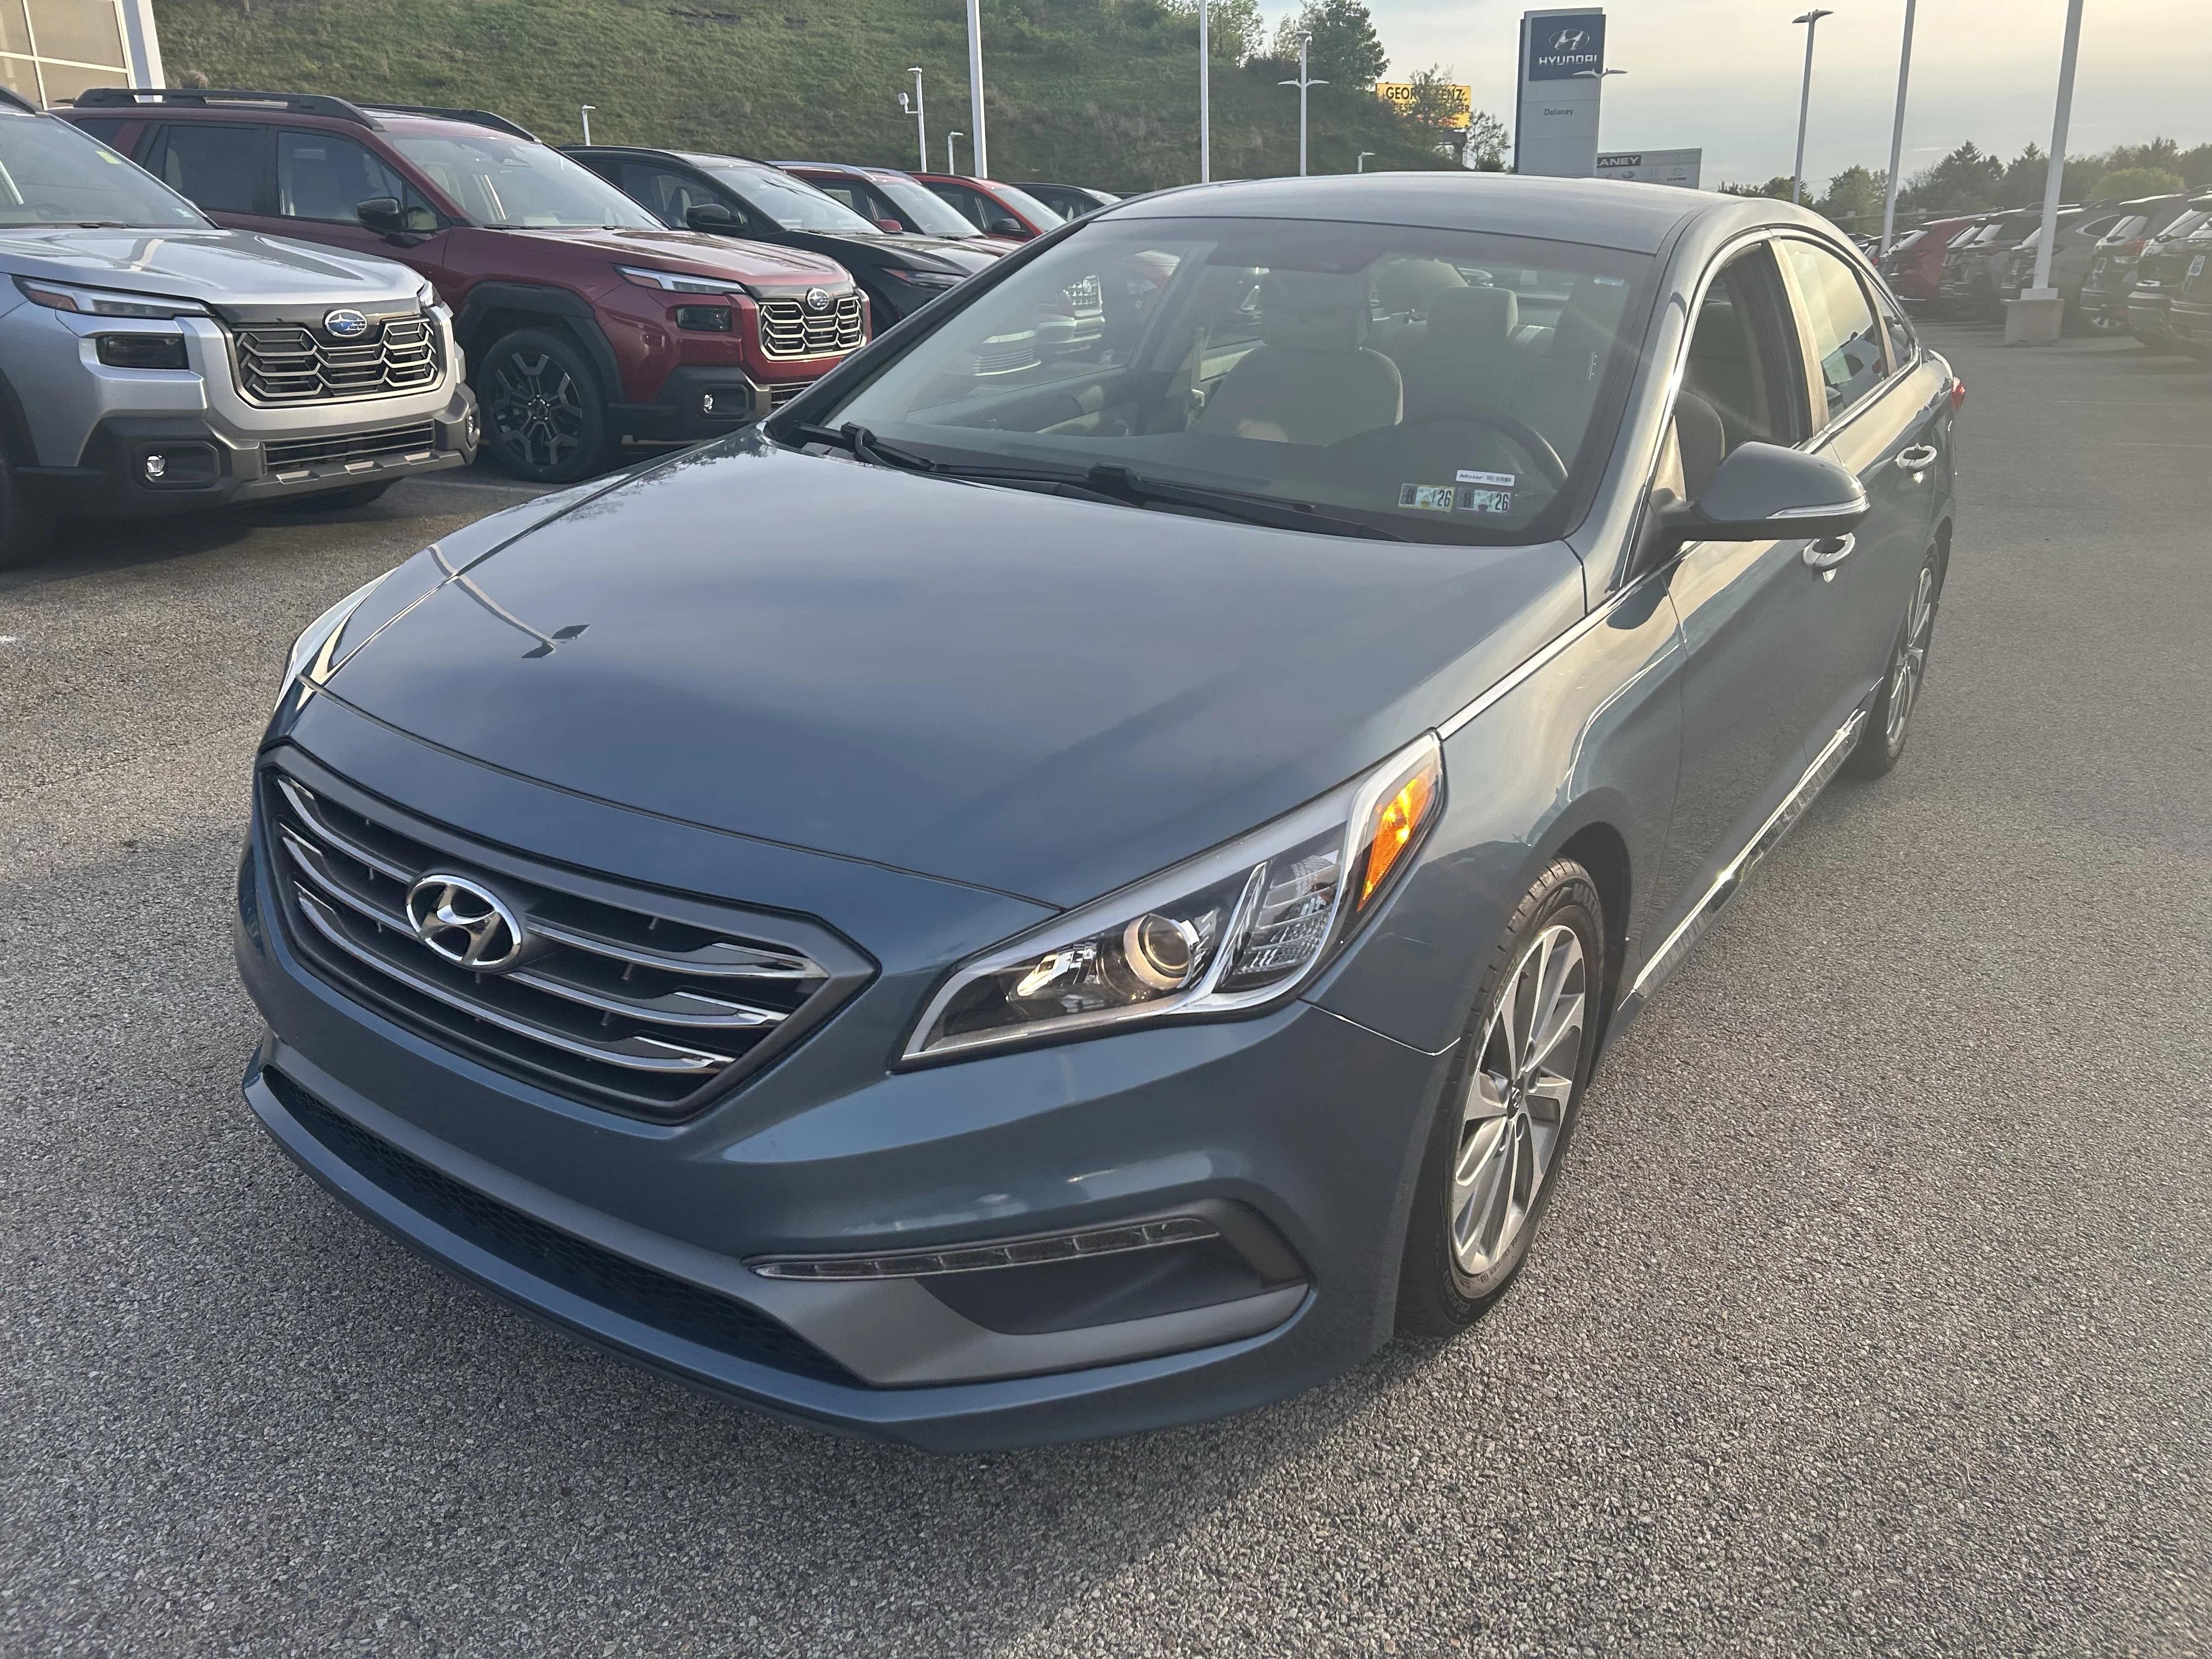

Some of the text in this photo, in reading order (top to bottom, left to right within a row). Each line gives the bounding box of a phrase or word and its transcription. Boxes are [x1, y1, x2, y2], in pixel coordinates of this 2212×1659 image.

[1539, 54, 1597, 65] HYUNDAI
[1386, 87, 1416, 100] GEOR
[1544, 108, 1575, 116] Delaney
[1597, 156, 1639, 166] ANEY
[1437, 490, 1452, 507] 26
[1495, 493, 1509, 511] 26
